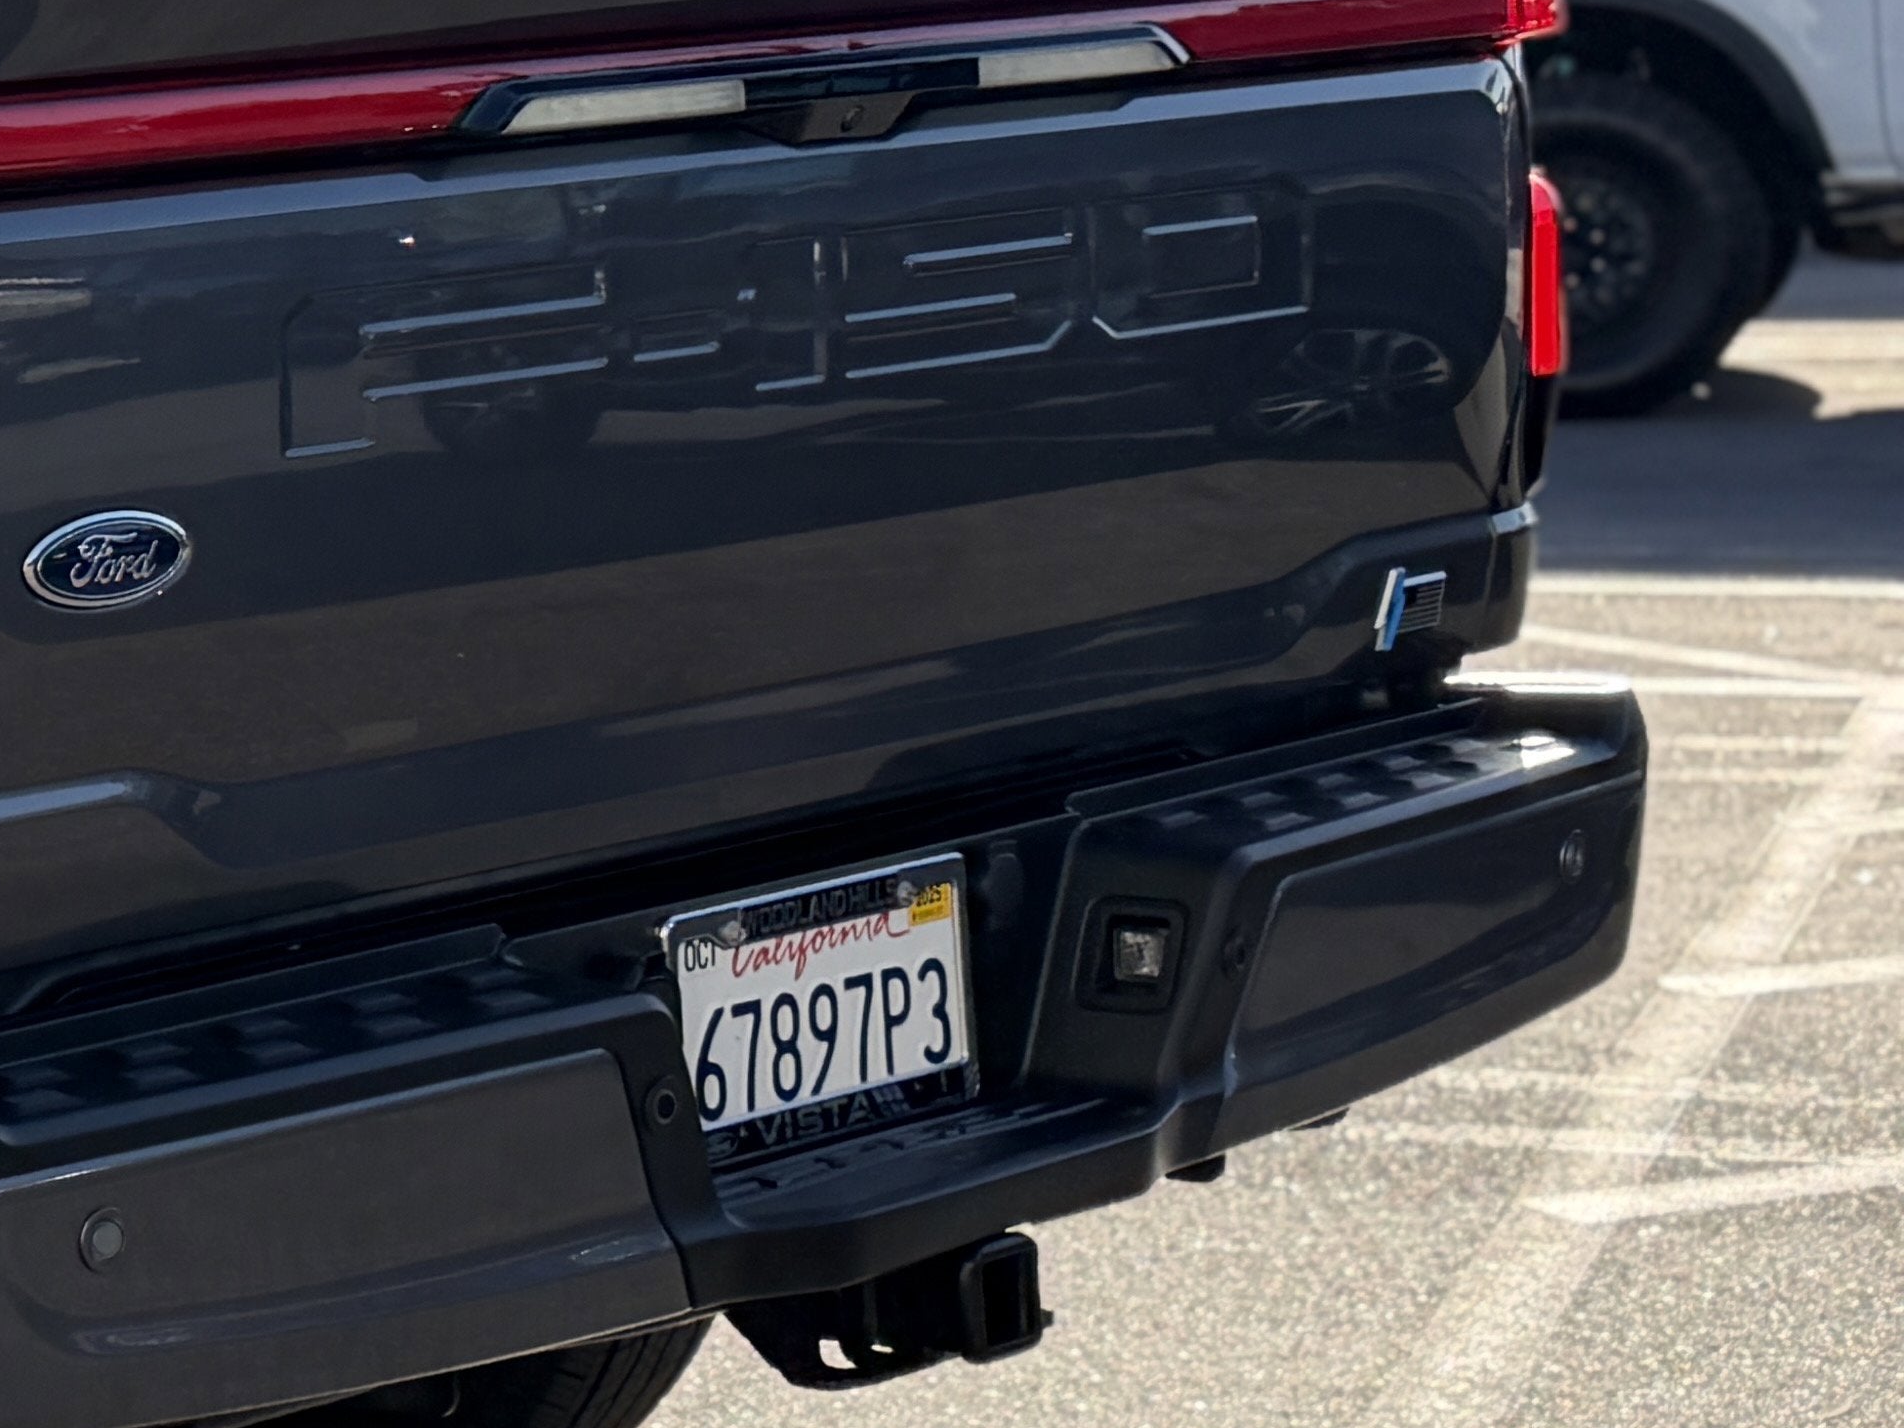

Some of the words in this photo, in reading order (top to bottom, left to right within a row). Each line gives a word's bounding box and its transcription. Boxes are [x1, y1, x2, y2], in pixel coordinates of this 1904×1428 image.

[281, 184, 1313, 458] F-150
[70, 532, 159, 588] Ford
[745, 890, 852, 939] WOODLAND
[852, 879, 899, 913] HILLS
[732, 912, 910, 980] California
[695, 958, 952, 1122] 67897P3
[755, 1094, 877, 1145] VISTA
